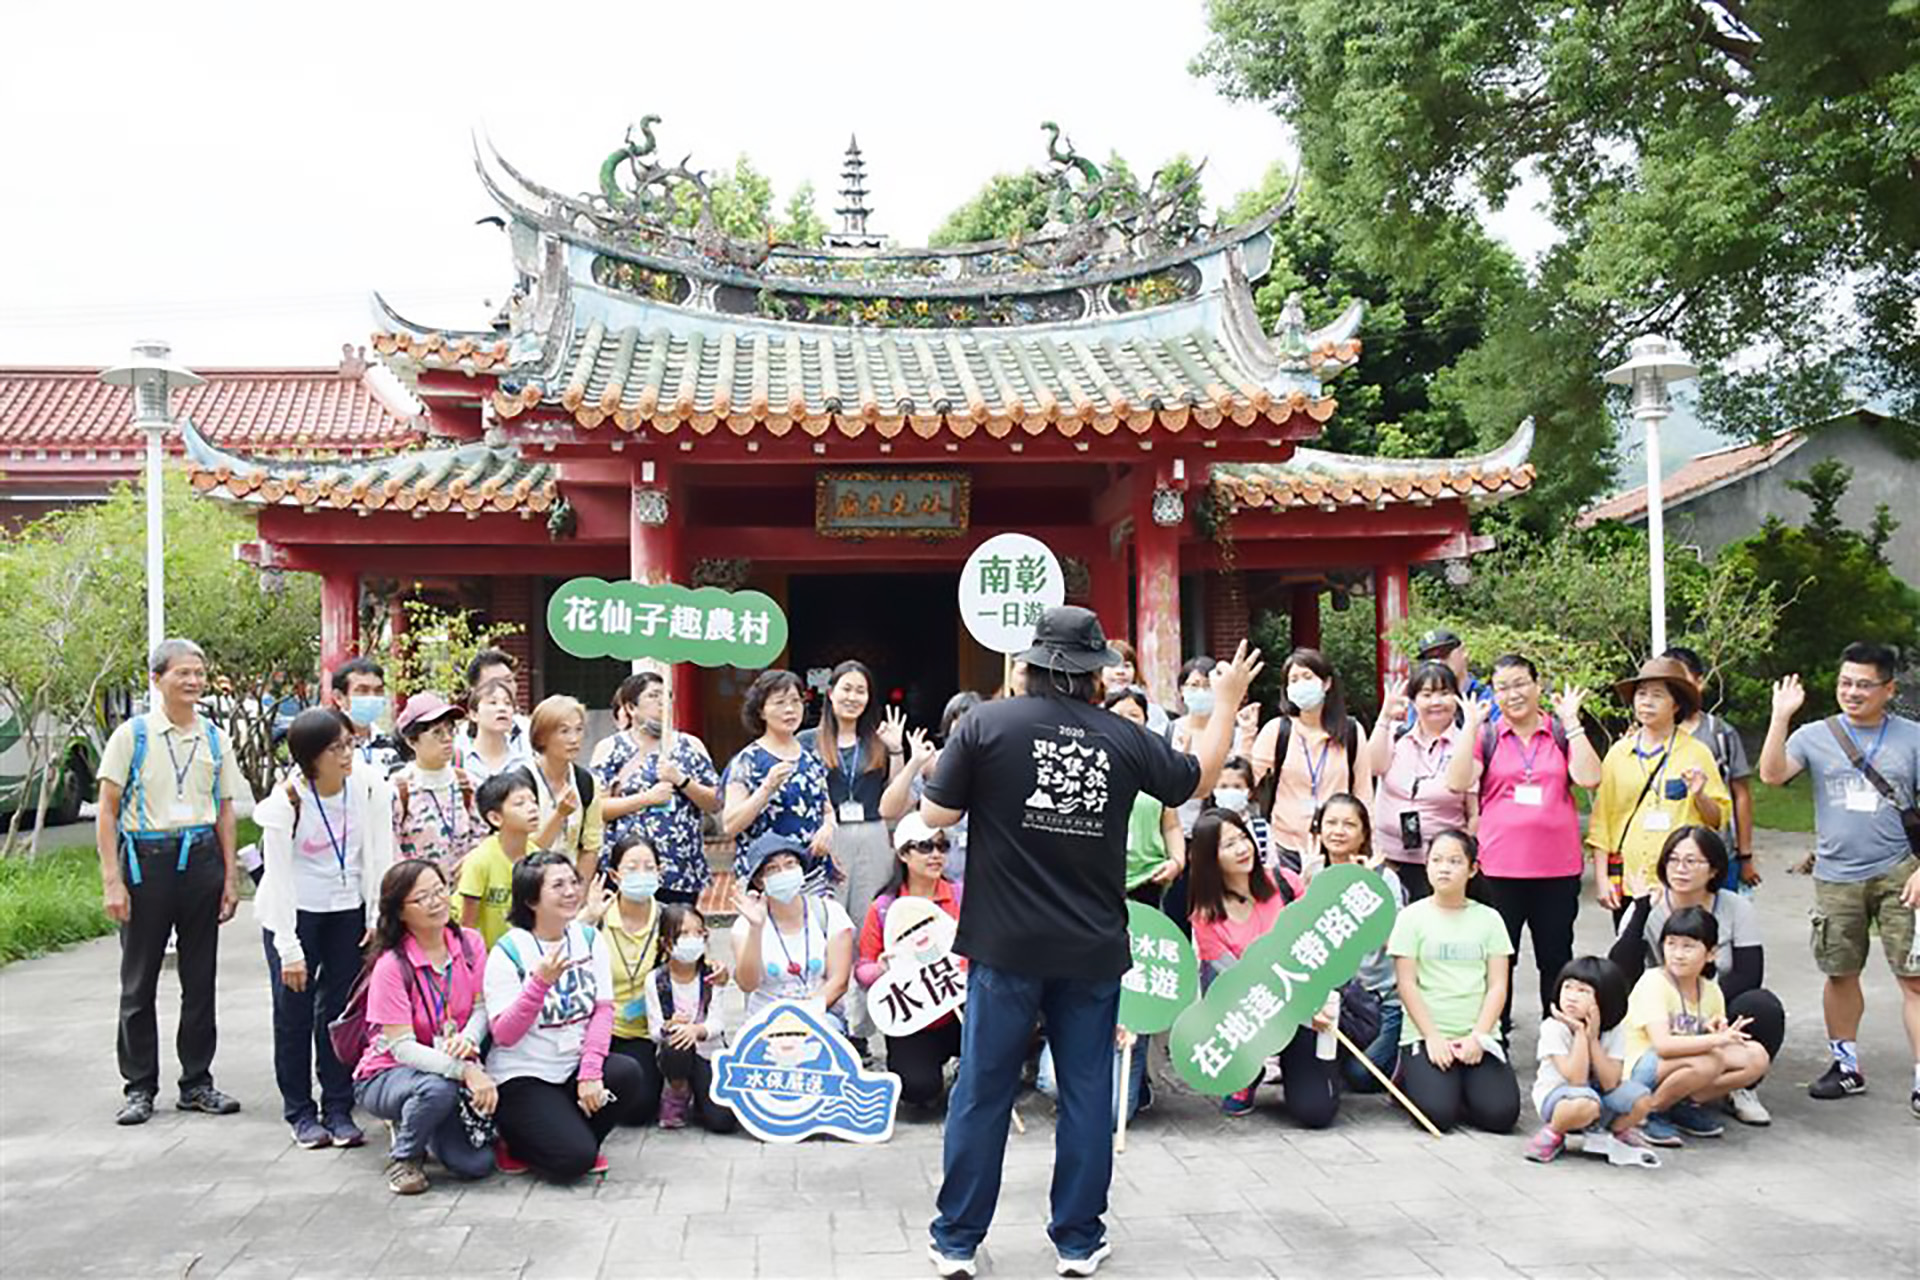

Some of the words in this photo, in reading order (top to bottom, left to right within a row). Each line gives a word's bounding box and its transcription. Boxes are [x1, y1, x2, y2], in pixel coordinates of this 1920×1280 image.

[978, 554, 1048, 595] 南彰
[562, 595, 771, 645] 花仙子趣農村
[1058, 725, 1086, 738] 2020
[878, 956, 965, 1024] 水保
[1190, 879, 1384, 1079] 在地達人帶路趣
